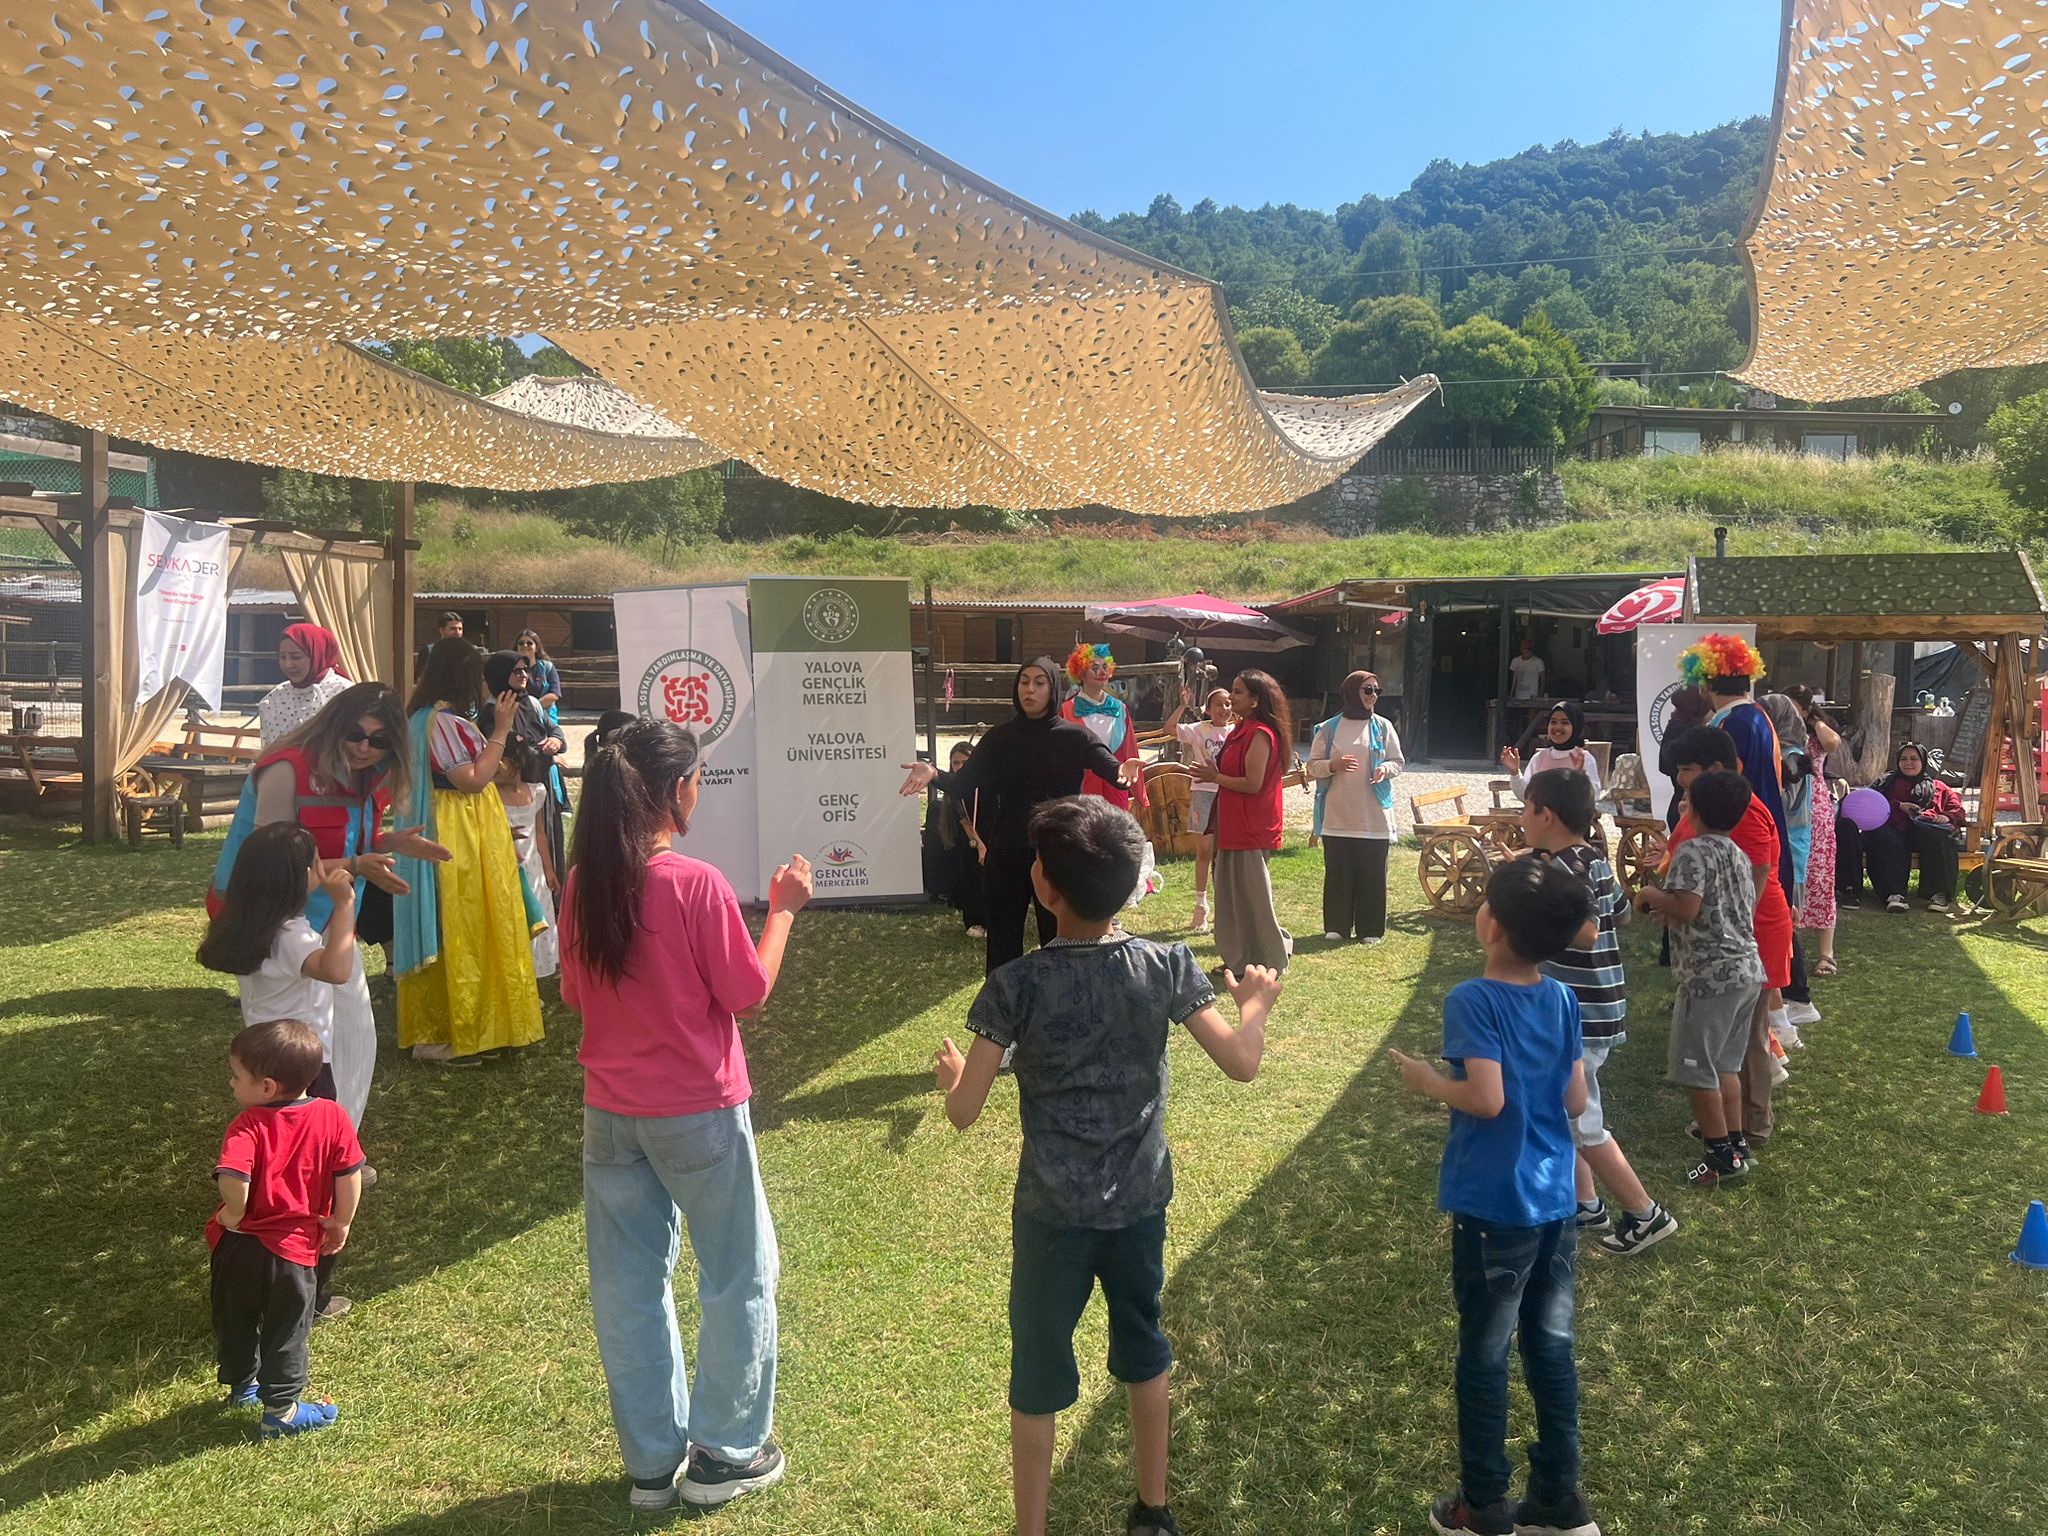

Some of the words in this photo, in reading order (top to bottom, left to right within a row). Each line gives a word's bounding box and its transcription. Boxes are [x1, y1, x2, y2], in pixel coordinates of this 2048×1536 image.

[147, 553, 219, 576] SEVKADER
[648, 651, 703, 675] YARDIMLAŞMA
[704, 656, 715, 668] VE
[804, 661, 863, 674] YALOVA
[639, 676, 653, 706] SOSYAL
[714, 664, 734, 711] DAYANIŞMA
[802, 675, 866, 692] GENÇLİK
[802, 690, 867, 705] MERKEZİ
[1651, 700, 1664, 726] SOSYAL
[712, 713, 731, 736] VAKFI
[807, 732, 866, 745] YALOVA
[786, 745, 887, 761] ÜNİVERSİTESİ
[737, 767, 749, 775] VE
[704, 778, 733, 786] VAKFI
[818, 793, 860, 809] GENÇ
[822, 808, 857, 822] OFİS
[815, 867, 867, 879] GENÇLİK
[815, 878, 869, 888] MERKEZLERİ
